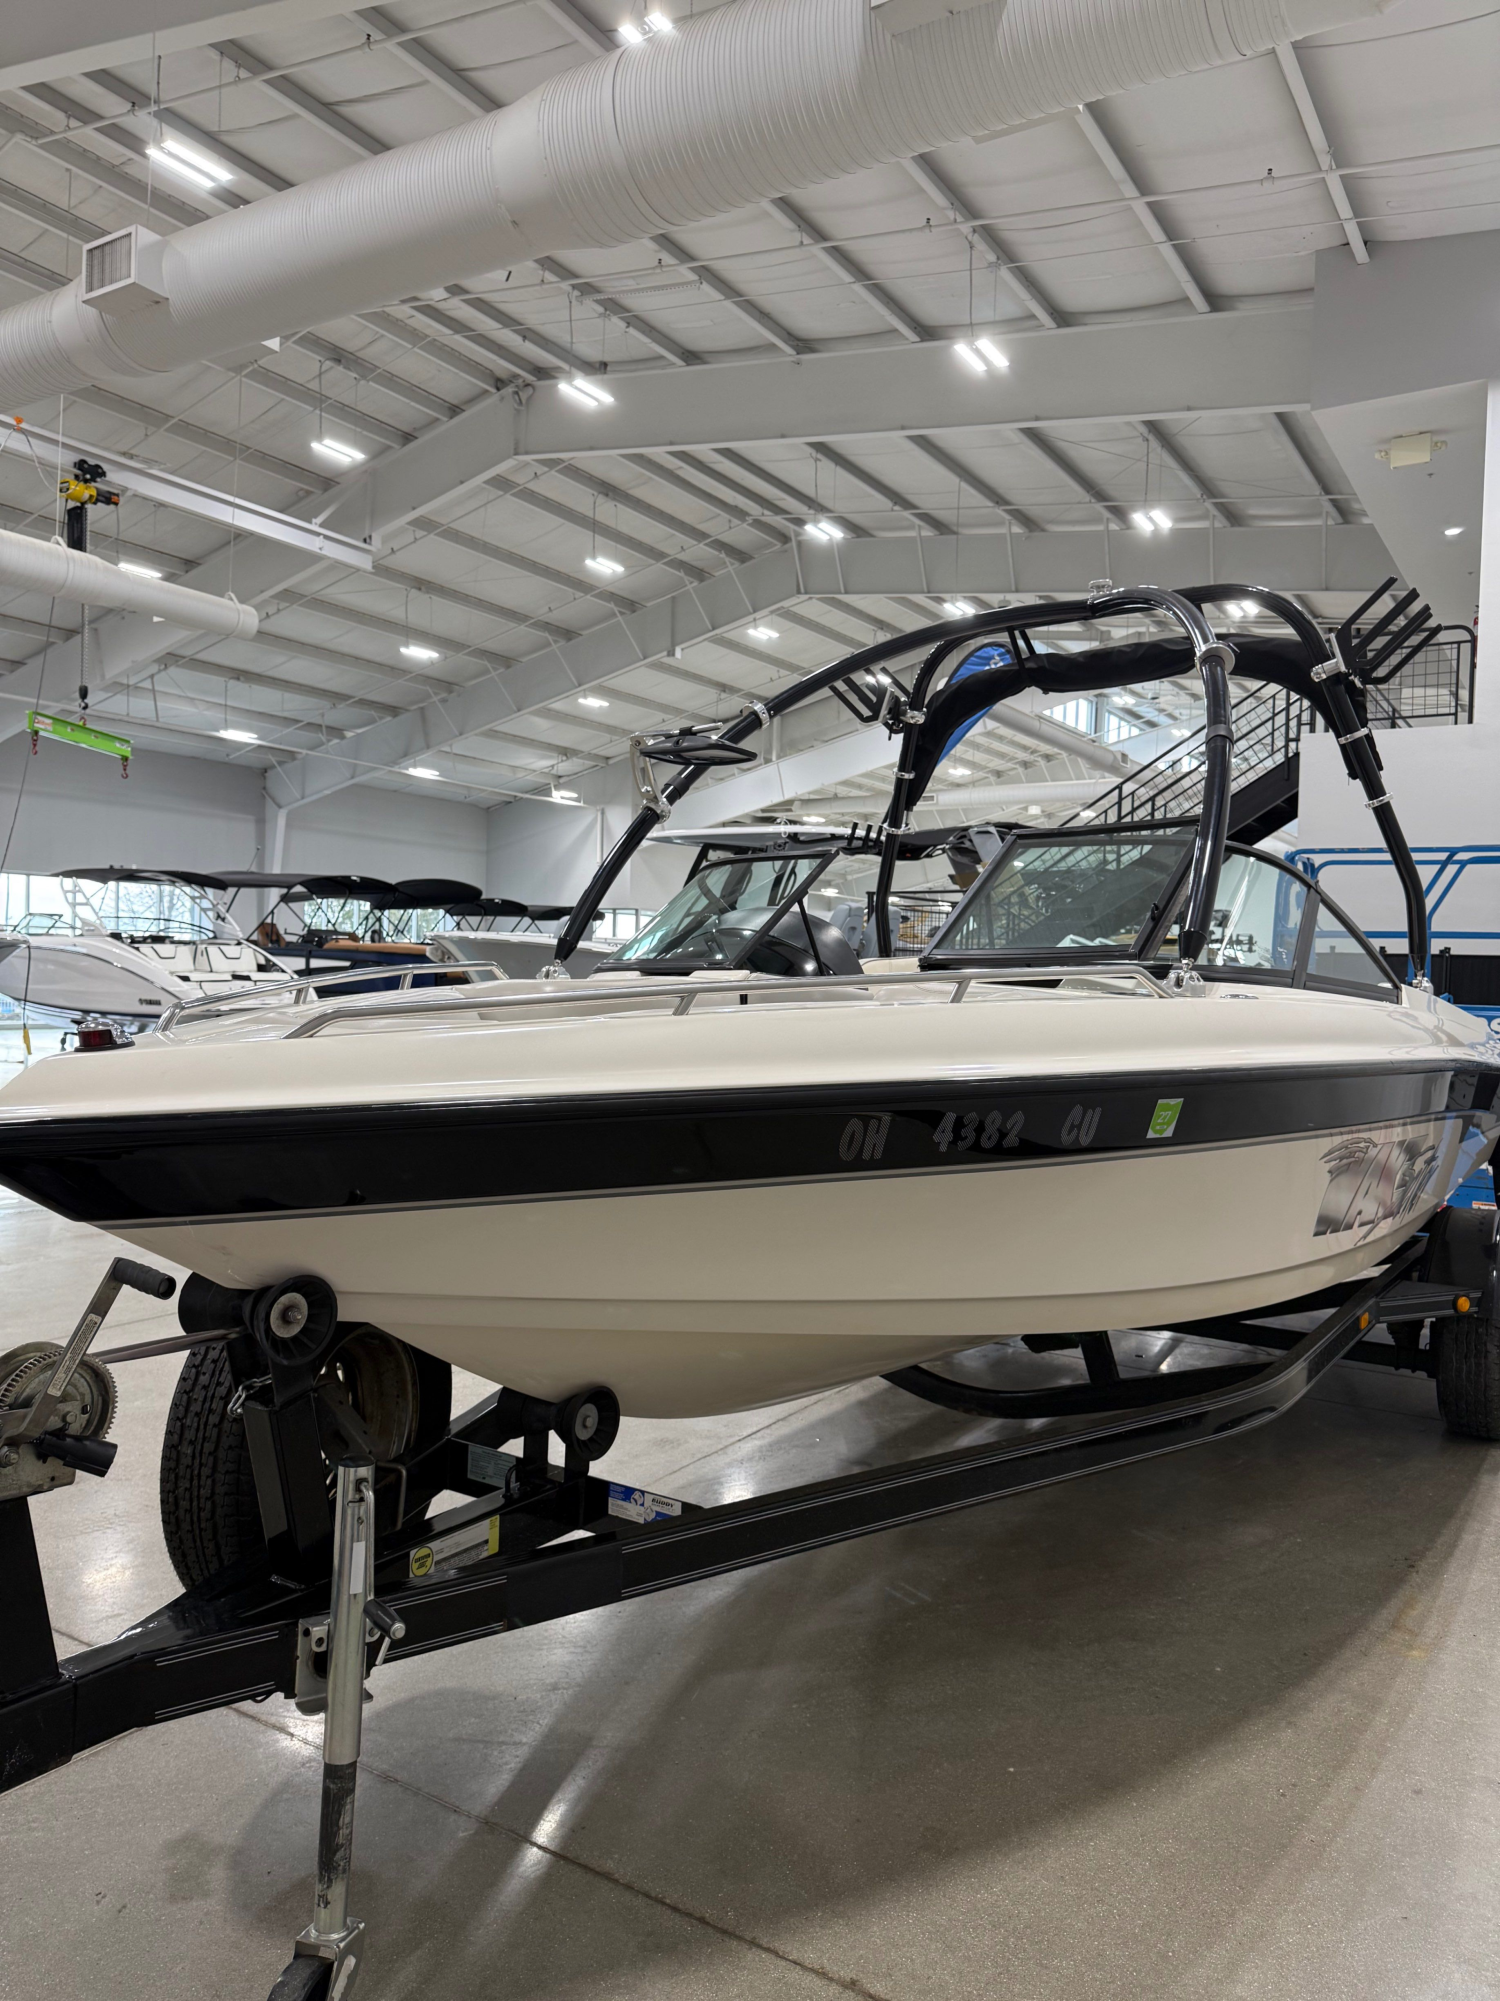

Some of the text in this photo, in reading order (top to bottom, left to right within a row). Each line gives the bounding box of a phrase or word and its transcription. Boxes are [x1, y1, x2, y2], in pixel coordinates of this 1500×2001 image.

[839, 1104, 1102, 1161] OH 4382 CU
[1157, 1111, 1172, 1123] 27
